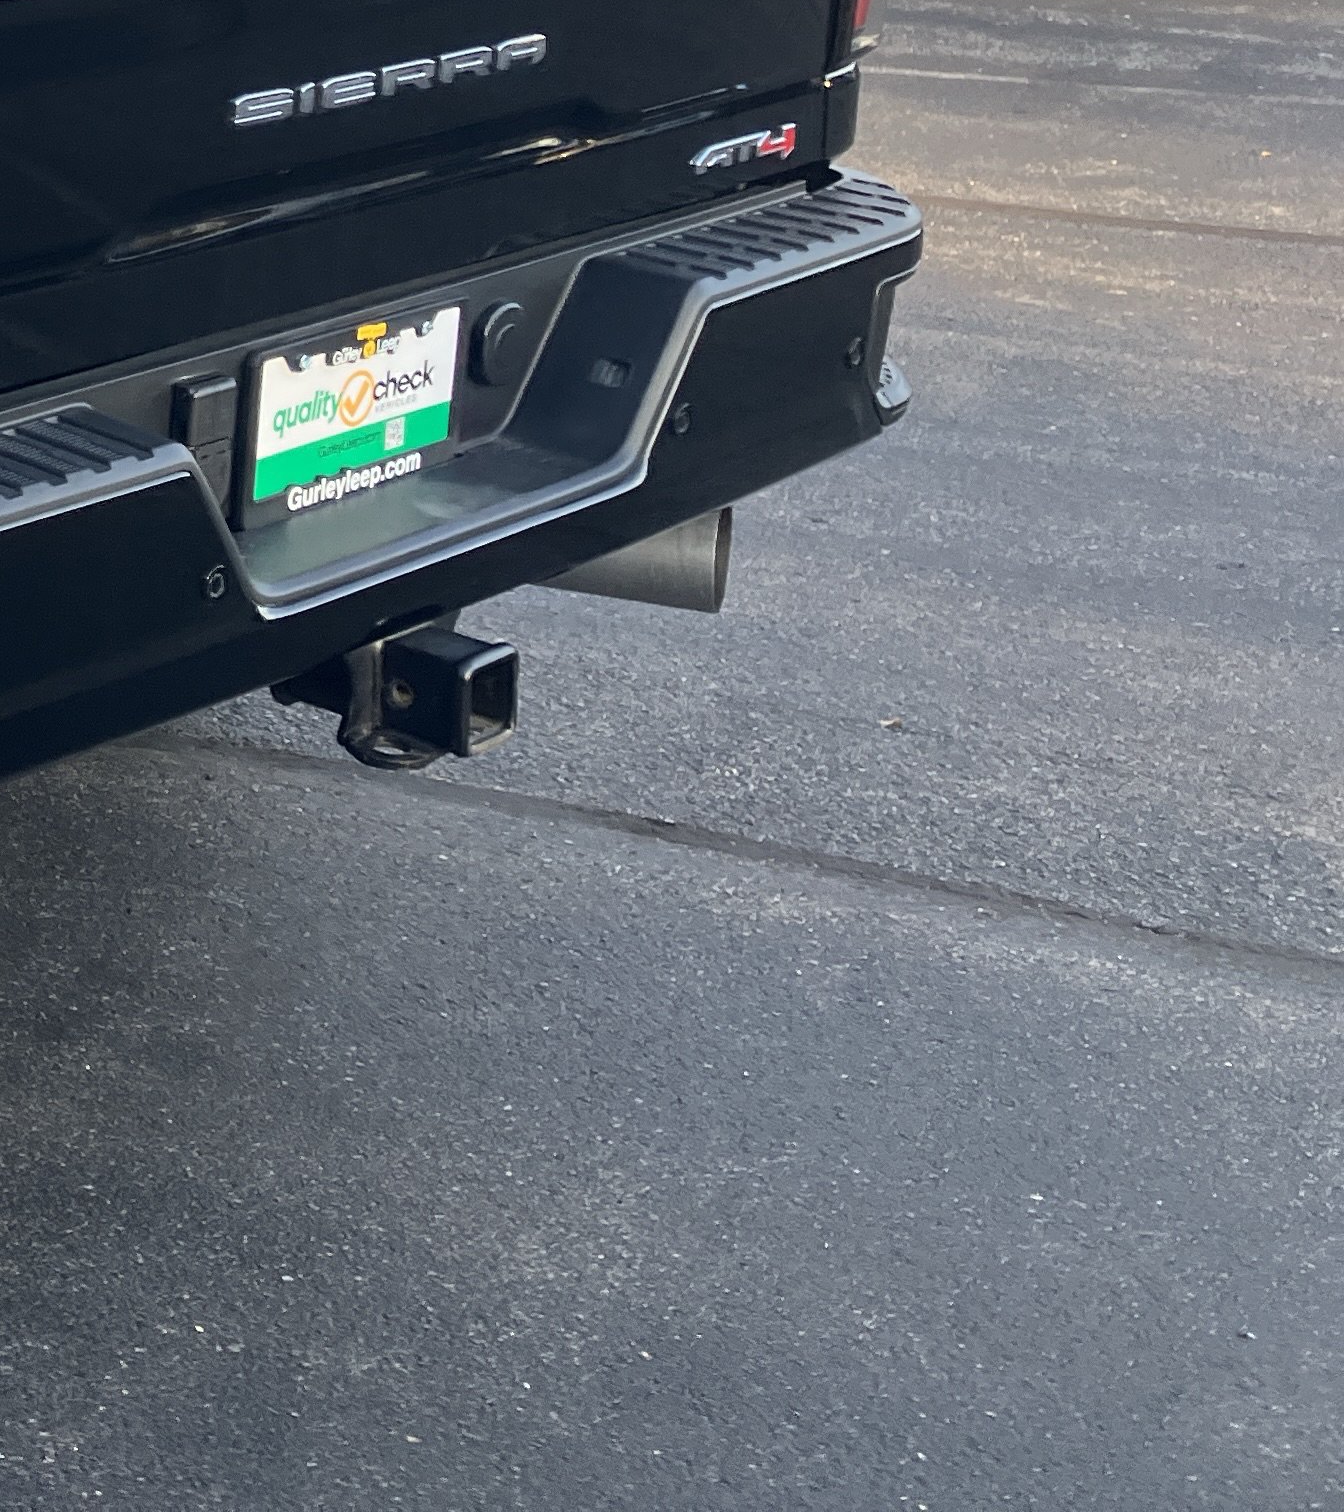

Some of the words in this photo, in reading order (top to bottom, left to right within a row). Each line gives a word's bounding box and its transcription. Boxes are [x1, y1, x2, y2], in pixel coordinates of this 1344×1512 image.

[232, 33, 548, 127] SIERRA
[689, 122, 796, 175] AT4
[273, 389, 343, 437] quality
[374, 360, 435, 401] check
[287, 452, 422, 512] Gurleyleep.com
